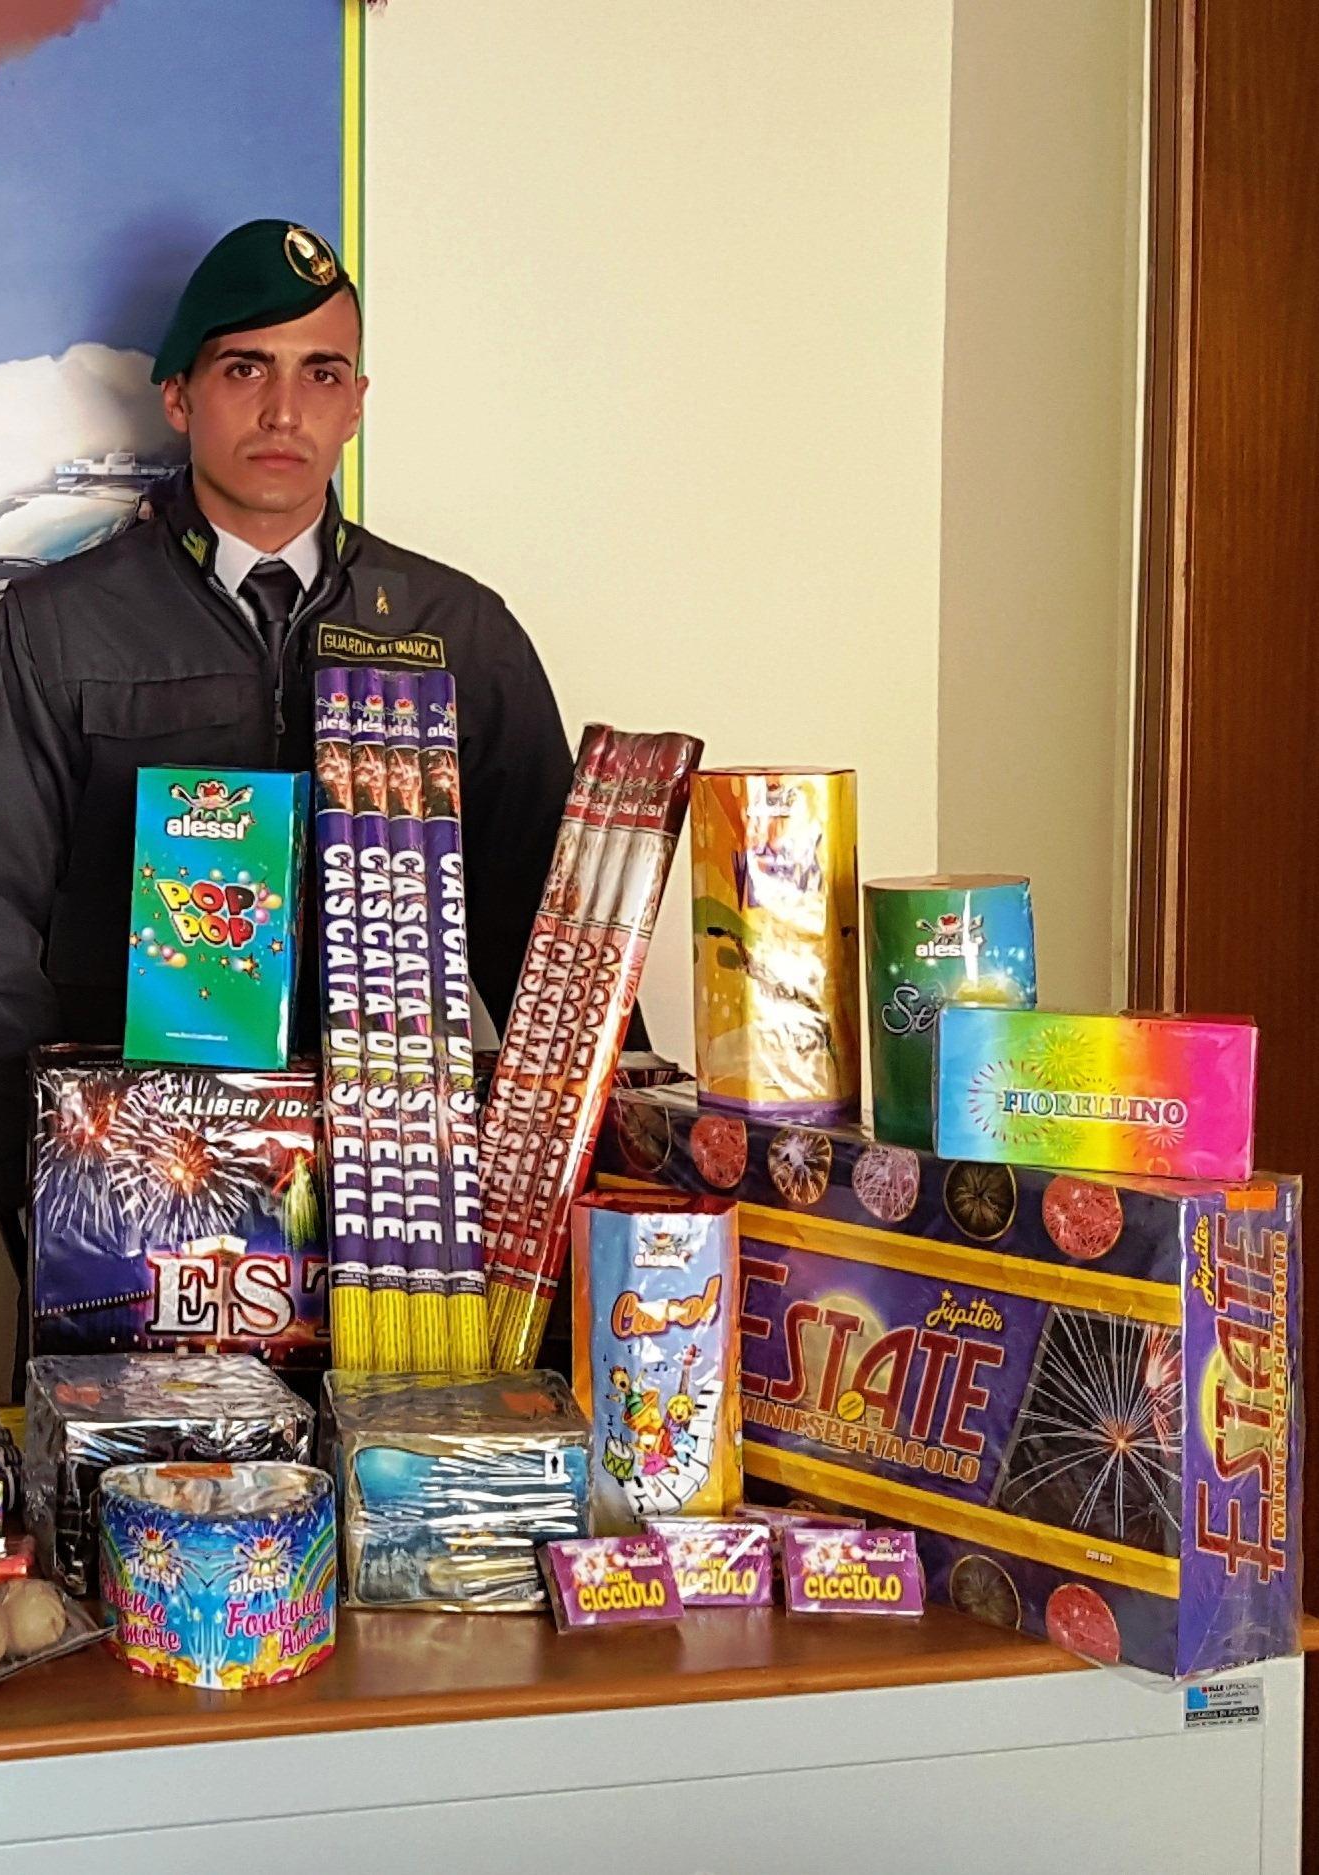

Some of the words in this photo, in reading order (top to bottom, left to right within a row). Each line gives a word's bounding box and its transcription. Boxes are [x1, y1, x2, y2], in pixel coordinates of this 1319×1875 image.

[324, 634, 375, 655] GUARDIA
[165, 813, 255, 840] alessi
[155, 879, 258, 916] POP
[169, 912, 256, 950] POP
[324, 844, 360, 1014] CASCATA
[360, 847, 396, 1015] CASCATA
[392, 850, 431, 1021] CASCATA
[331, 1029, 361, 1066] DI
[367, 1031, 399, 1070] DI
[399, 1035, 434, 1074] DI
[160, 1097, 261, 1117] KALIBER
[1001, 1088, 1189, 1127] FIORELLINO
[332, 1081, 368, 1239] STELLE
[367, 1085, 406, 1242] STELLE
[400, 1090, 444, 1245] STELLE
[740, 1256, 1005, 1455] ESTATE
[1195, 1212, 1286, 1585] ESTATE
[228, 1570, 290, 1595] alessi
[577, 1578, 667, 1613] CICCIOLO
[803, 1573, 903, 1602] CICCIOLO
[225, 1588, 324, 1638] Fontana
